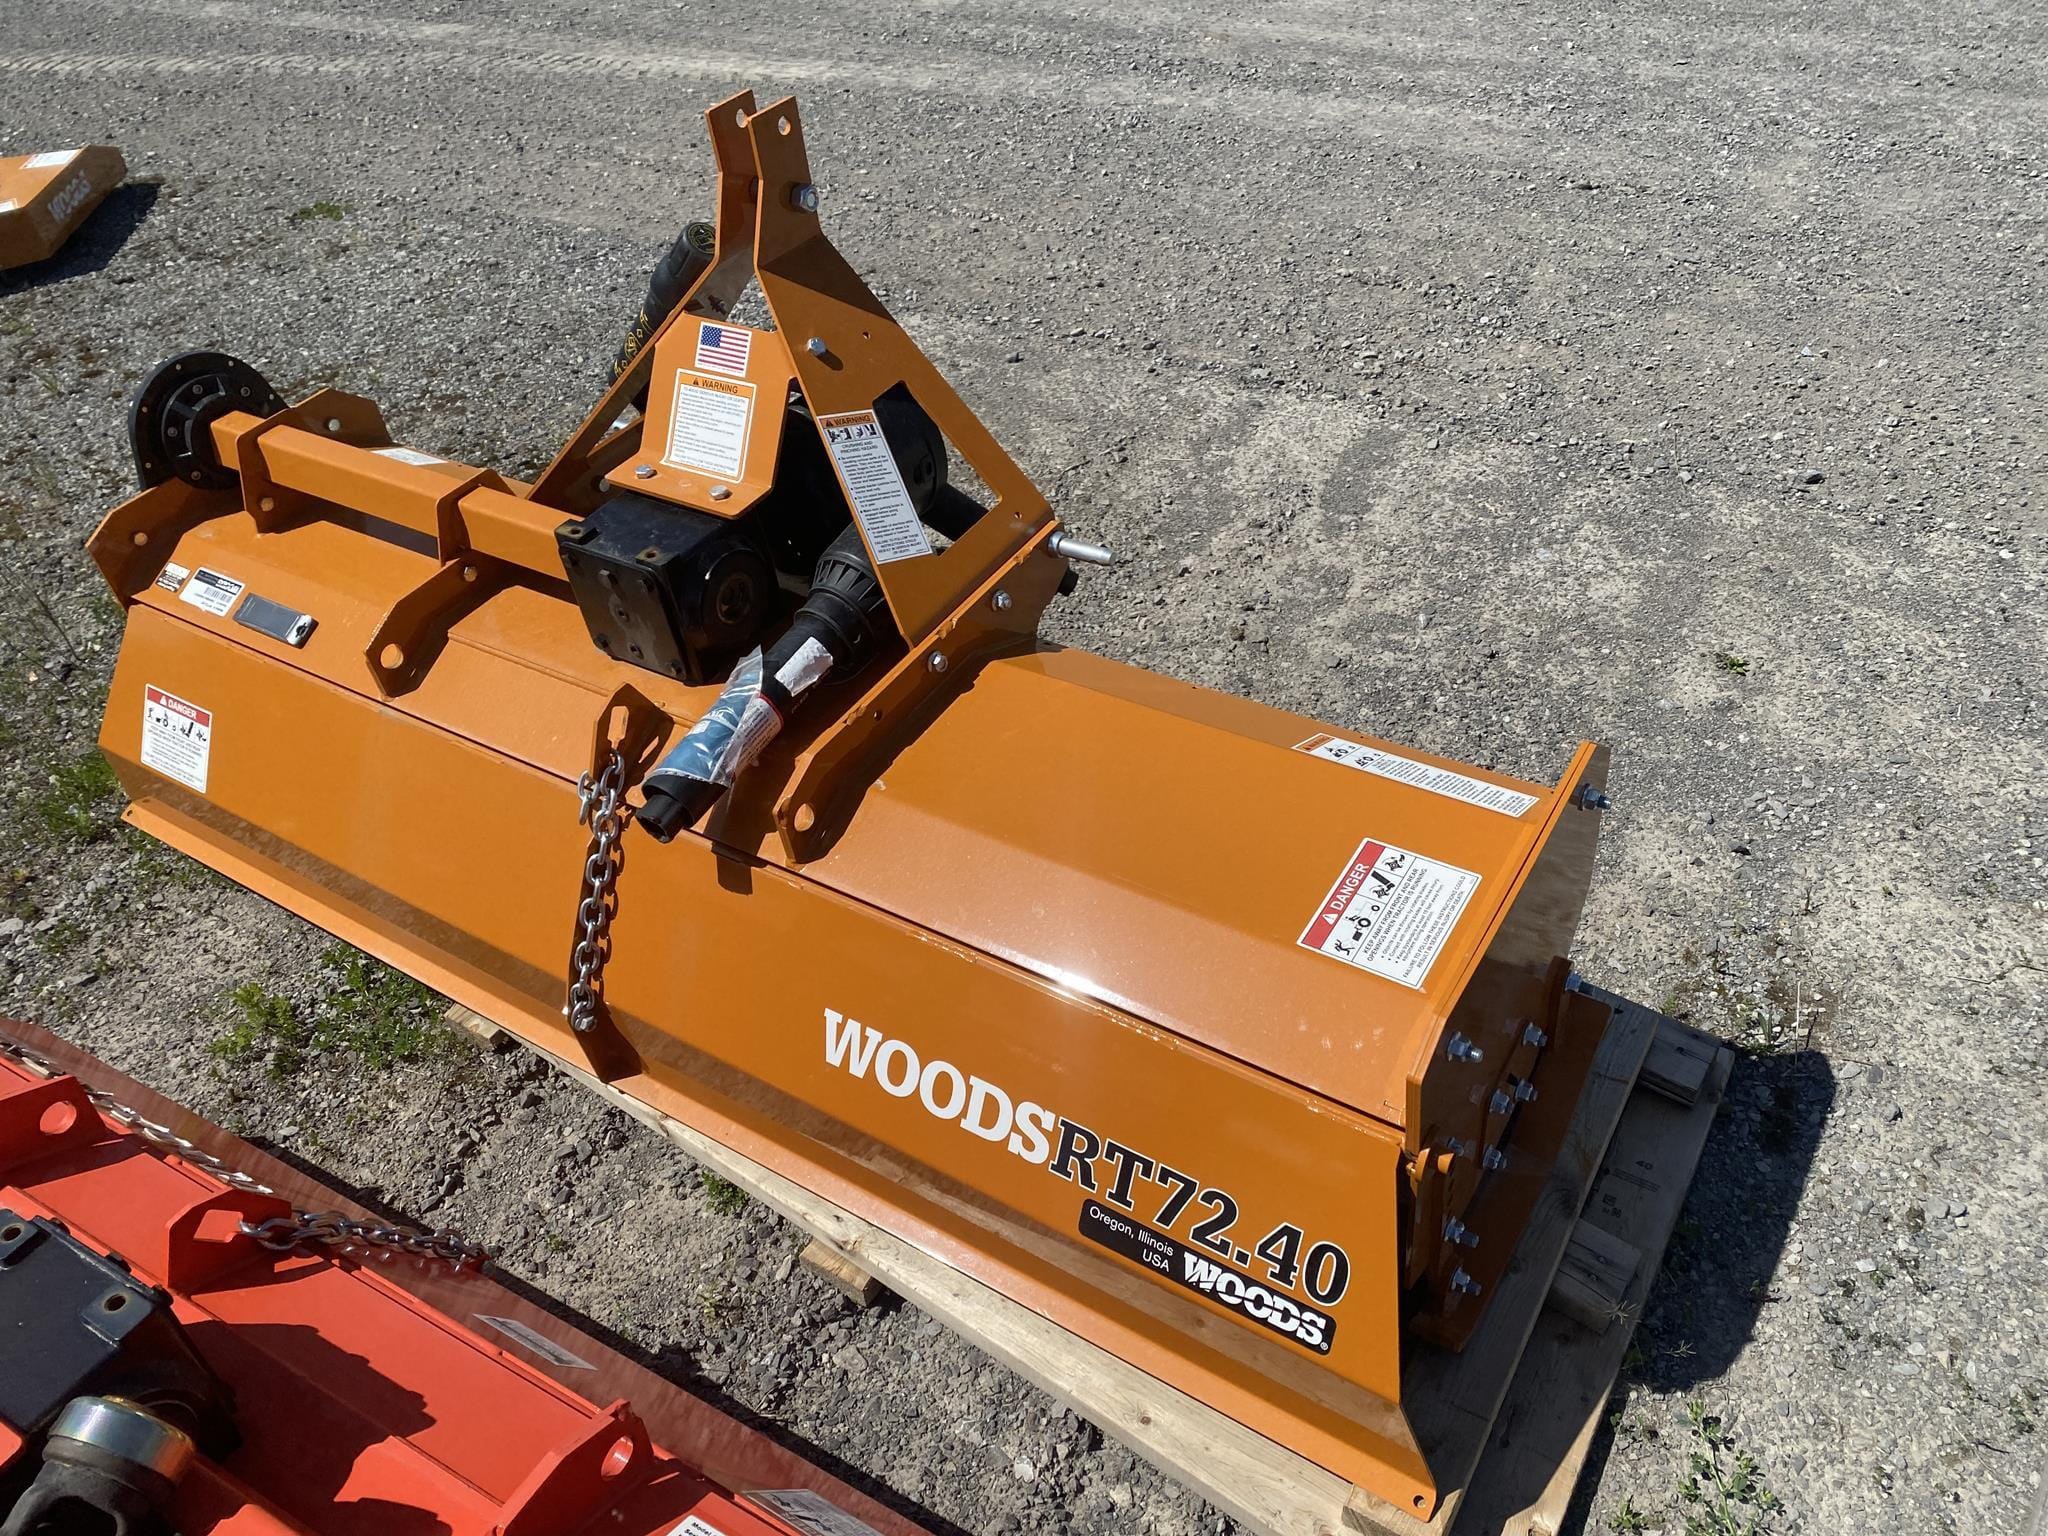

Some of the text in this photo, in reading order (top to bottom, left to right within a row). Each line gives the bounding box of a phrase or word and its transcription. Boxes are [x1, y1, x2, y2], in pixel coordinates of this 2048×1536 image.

[701, 379, 738, 394] WARNING
[833, 414, 871, 425] WARNING
[167, 698, 196, 719] DANGER
[1329, 861, 1369, 910] DANGER
[1362, 867, 1418, 953] KEEP AWAY FROM FRONT AND REAR
[1366, 934, 1387, 962] OPENINGS
[1382, 918, 1396, 935] WHEN
[1391, 895, 1411, 919] TRACTOR
[824, 1008, 1350, 1307] WOODS RT72.40
[1089, 1206, 1174, 1256] Oregon, Illinois
[1142, 1250, 1169, 1273] USA
